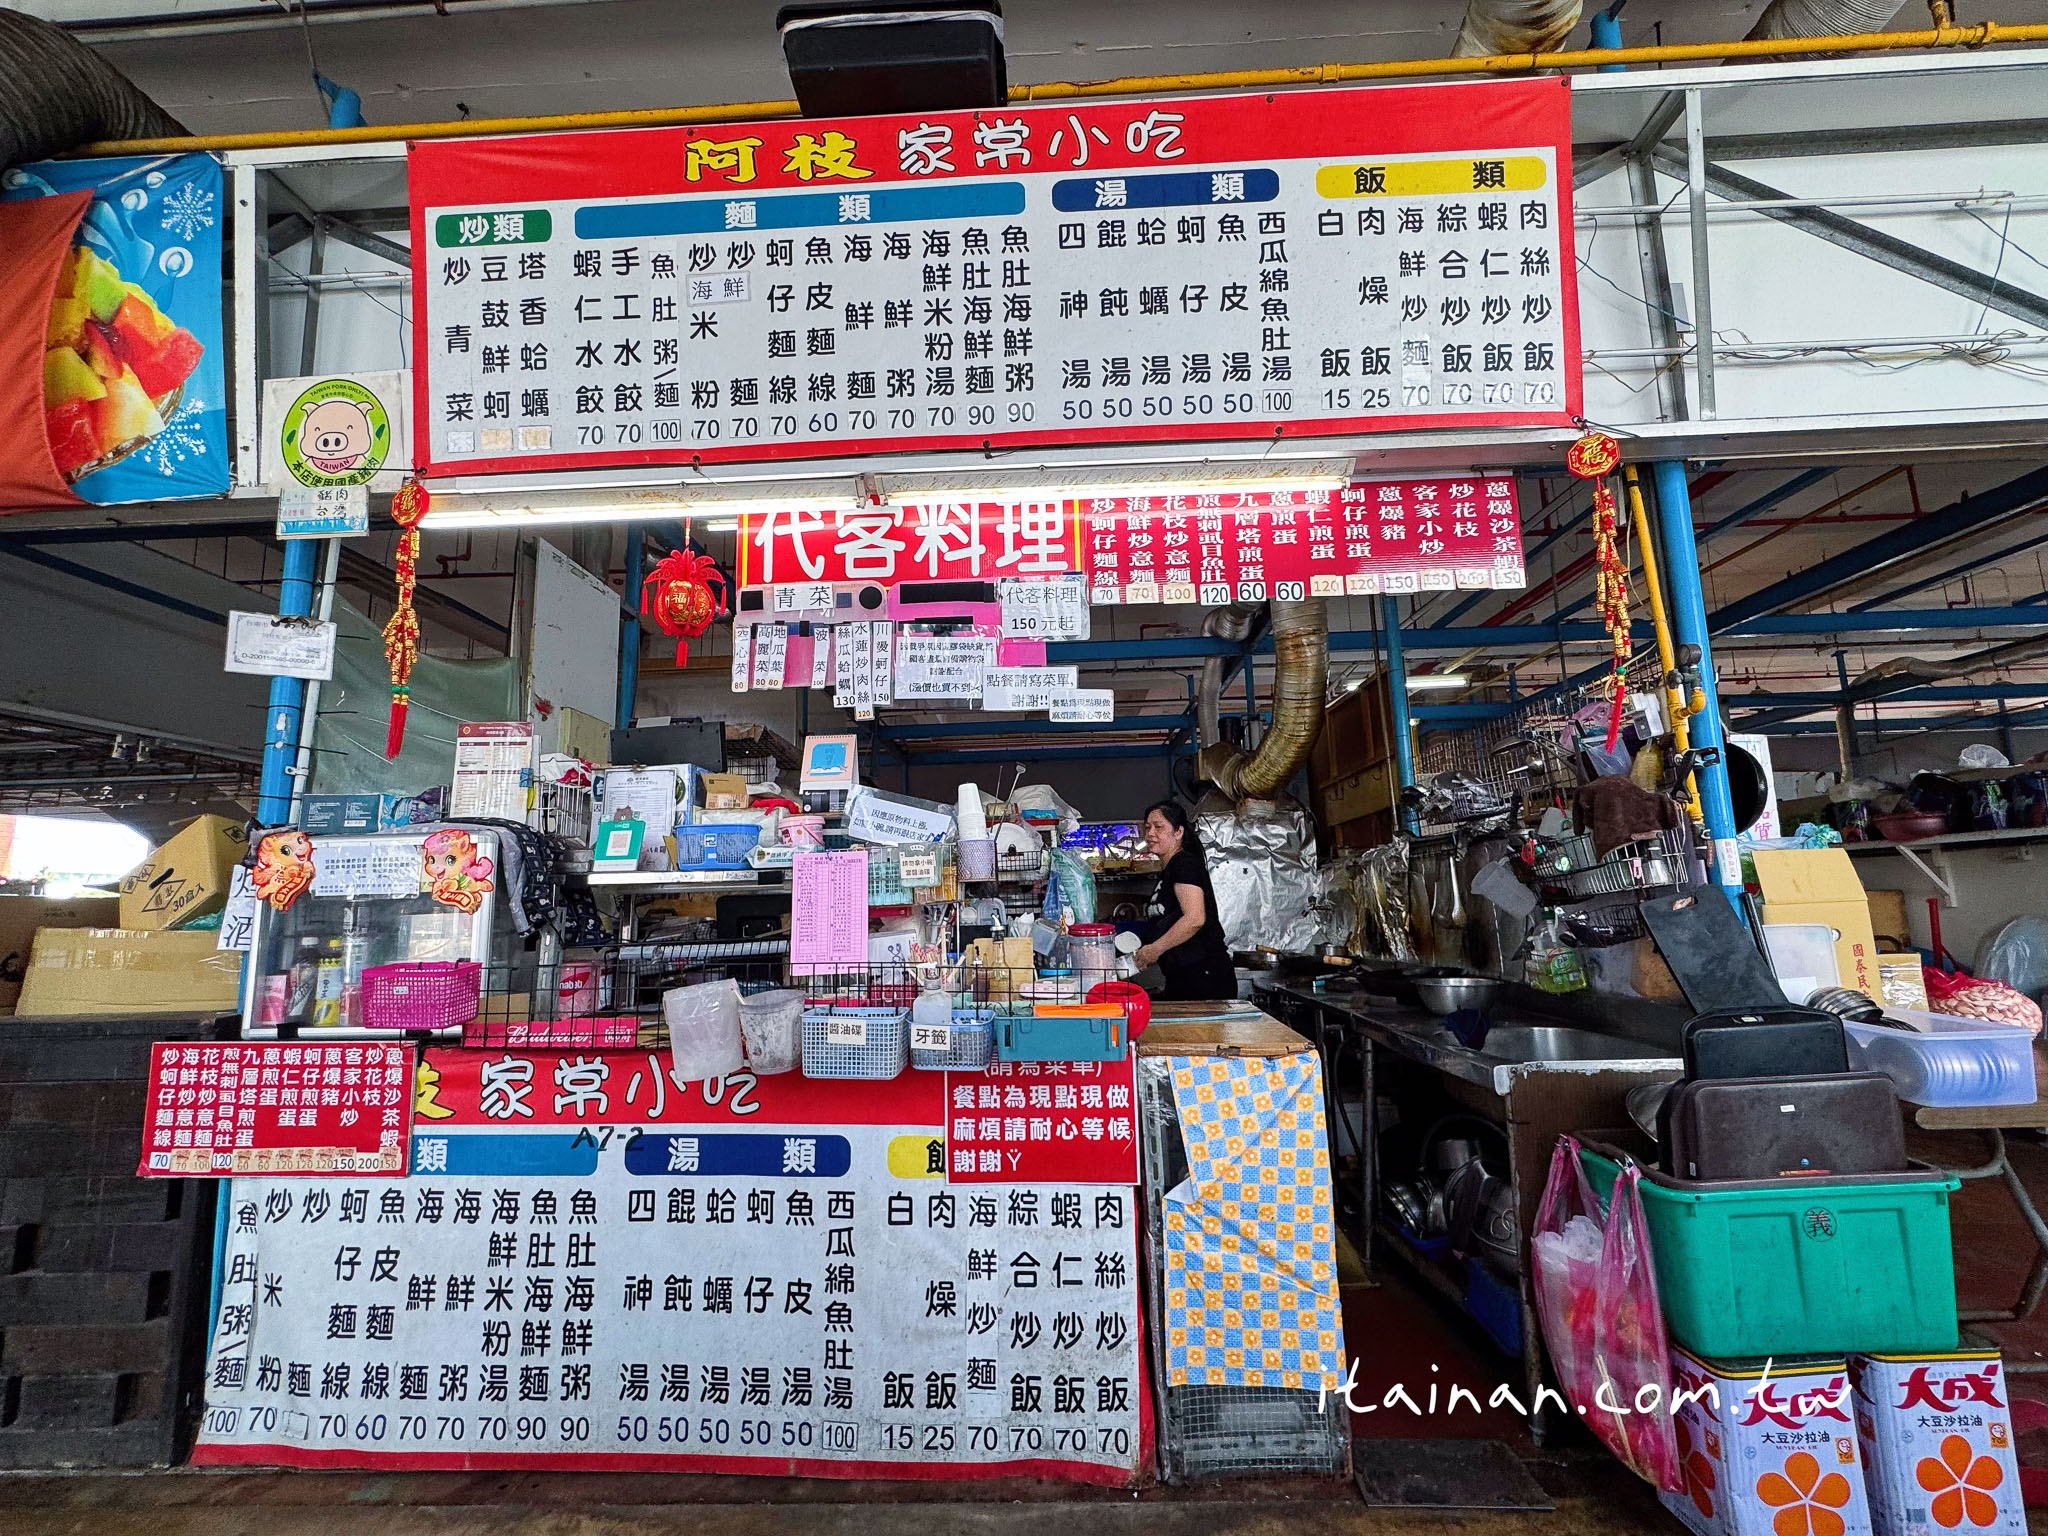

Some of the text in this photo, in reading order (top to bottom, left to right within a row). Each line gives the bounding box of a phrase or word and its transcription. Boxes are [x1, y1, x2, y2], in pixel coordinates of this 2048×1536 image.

[685, 109, 1186, 184] 阿枝 家常小吃
[1353, 161, 1506, 195] 飯類
[724, 193, 871, 229] 麵類
[1095, 172, 1245, 208] 湯類
[459, 213, 525, 243] 炒類
[692, 276, 745, 299] 海鮮
[805, 236, 836, 403] 魚皮麵線
[843, 234, 876, 401] 海鮮麵
[883, 231, 915, 399] 海鮮粥
[922, 229, 955, 396] 海鮮米粉湯
[962, 227, 994, 395] 魚肚海鮮麵
[1001, 224, 1034, 393] 魚肚海鮮粥
[1058, 223, 1091, 390] 四神湯
[1097, 220, 1131, 388] 餛飩湯
[1137, 218, 1171, 386] 蛤蠣湯
[1177, 216, 1211, 384] 蚵仔湯
[1217, 213, 1251, 382] 魚皮湯
[1258, 212, 1292, 381] 西瓜綿魚肚湯
[1318, 209, 1351, 378] 白飯
[1358, 207, 1391, 376] 肉燥飯
[1398, 208, 1429, 367] 海鮮炒麵
[1437, 204, 1472, 374] 綜合炒飯
[1477, 202, 1512, 372] 蝦仁炒飯
[1520, 200, 1555, 371] 肉絲炒飯
[442, 255, 474, 422] 炒青菜
[481, 256, 511, 419] 豆鼓鮮蚵
[518, 252, 549, 418] 塔香蛤蠣
[573, 250, 604, 415] 蝦仁水餃
[611, 246, 643, 413] 手工水餃
[766, 238, 798, 403] 蚵仔麵線
[310, 385, 331, 396] TAIWAN
[809, 412, 837, 433] 60
[888, 409, 915, 428] 70
[968, 405, 994, 425] 90
[1062, 400, 1092, 420] 50
[1142, 396, 1172, 417] 50
[1223, 393, 1253, 414] 50
[1324, 389, 1350, 409] 15
[1403, 386, 1429, 406] 70
[1484, 382, 1512, 403] 70
[577, 425, 603, 446] 70
[653, 422, 679, 441] 100
[732, 418, 758, 438] 70
[320, 459, 350, 470] TAIWAN
[754, 501, 1069, 583] 代客料理
[1091, 498, 1119, 586] 炒蚵仔麵線
[1125, 497, 1155, 584] 海鮮炒意麵
[1162, 496, 1191, 583] 花枝炒意麵
[1235, 493, 1263, 580] 九層塔煎蛋
[1305, 490, 1335, 558] 蝦仁煎蛋
[1341, 489, 1372, 557] 蚵仔煎蛋
[1377, 487, 1406, 540] 蔥爆豬
[1412, 485, 1445, 554] 客家小炒
[1449, 484, 1479, 537] 炒花枝
[776, 586, 833, 608] 青菜
[1007, 587, 1077, 604] 代客料理
[1100, 589, 1113, 600] 70
[1132, 588, 1149, 599] 70
[1166, 588, 1191, 599] 100
[1204, 586, 1228, 603] 120
[1239, 583, 1265, 600] 60
[1278, 583, 1303, 600] 60
[1314, 579, 1338, 591] 120
[1350, 578, 1374, 590] 120
[735, 627, 748, 675] 空心菜
[770, 627, 786, 672] 地瓜葉
[814, 629, 828, 672] 波菜
[1012, 617, 1074, 631] 150 元起
[855, 624, 869, 703] 水蓮炒肉絲
[874, 693, 889, 701] 150
[836, 696, 855, 706] 130
[172, 883, 205, 913] 30盒入
[829, 1022, 863, 1037] 醬油碟
[915, 1027, 947, 1047] 牙籤
[154, 1049, 180, 1146] 炒蚵仔麵線
[194, 1049, 219, 1146] 花枝炒意麵
[215, 1048, 241, 1147] 煎無刺虱目魚肚
[235, 1048, 260, 1147] 九層塔煎蛋
[278, 1049, 301, 1126] 蝦仁煎蛋
[321, 1048, 343, 1105] 蔥爆豬
[340, 1048, 363, 1126] 客家小炒
[479, 1054, 761, 1120] 家常小吃
[953, 1085, 1129, 1109] 餐點為現點現做
[214, 1155, 231, 1166] 120
[572, 1126, 645, 1152] A7-2
[667, 1137, 817, 1173] 湯類
[953, 1117, 1131, 1141] 麻煩請耐心等候
[333, 1158, 354, 1169] 150
[358, 1158, 379, 1169] 200
[1807, 1210, 1834, 1238] 義
[321, 1187, 368, 1400] 蚵仔麵線
[361, 1187, 405, 1401] 魚皮麵線
[400, 1188, 444, 1401] 海鮮麵
[439, 1188, 482, 1402] 海鮮粥
[478, 1188, 521, 1402] 海鮮米粉湯
[518, 1188, 558, 1402] 魚肚海鮮麵
[560, 1188, 597, 1402] 魚肚海鮮粥
[619, 1190, 656, 1402] 四神湯
[660, 1188, 696, 1402] 餛飩湯
[701, 1188, 737, 1403] 蛤蠣湯
[740, 1188, 775, 1404] 蚵仔湯
[781, 1189, 815, 1406] 魚皮湯
[824, 1191, 856, 1409] 西瓜綿魚肚湯
[883, 1191, 914, 1409] 白飯
[925, 1191, 957, 1410] 肉燥飯
[967, 1194, 998, 1392] 海鮮炒麵
[1008, 1189, 1041, 1412] 綜合炒飯
[1051, 1192, 1085, 1412] 蝦仁炒飯
[1094, 1192, 1128, 1412] 肉絲炒飯
[1893, 1364, 2006, 1413] 大成
[1917, 1415, 1983, 1428] 大豆沙拉油
[479, 1417, 505, 1439] 70
[782, 1419, 813, 1445] 50
[1099, 1429, 1129, 1453] 70
[1761, 1431, 1830, 1444] 大豆沙拉油
